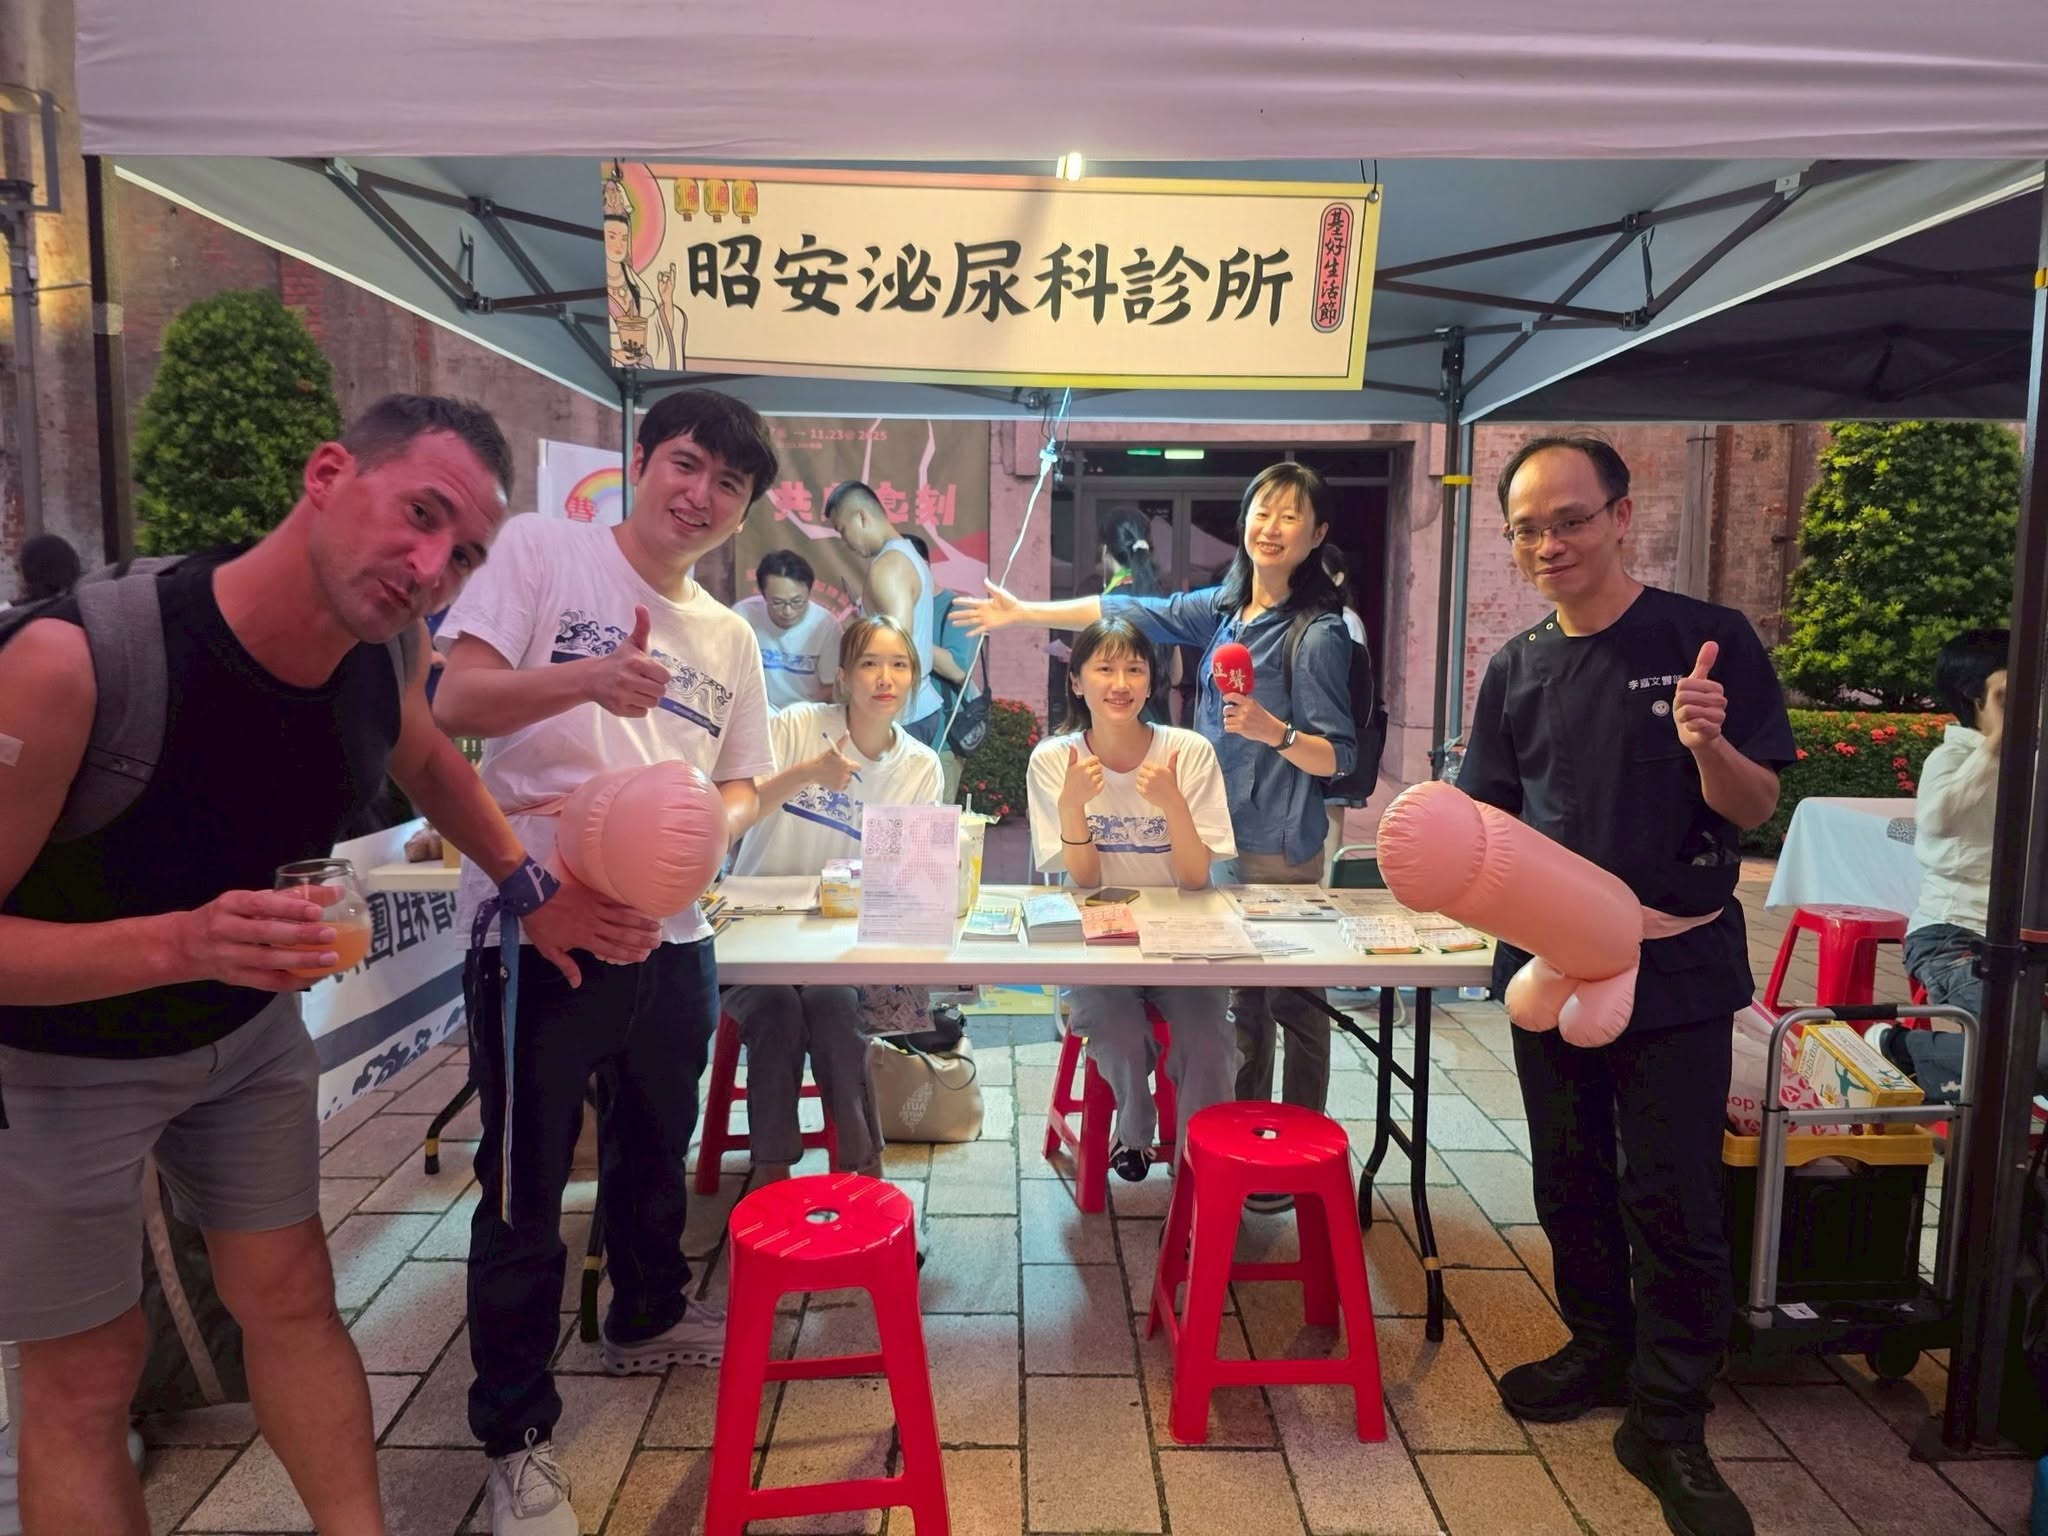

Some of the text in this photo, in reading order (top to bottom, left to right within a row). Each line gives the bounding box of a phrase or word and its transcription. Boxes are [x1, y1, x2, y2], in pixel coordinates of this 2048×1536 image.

[687, 234, 1294, 327] 昭安泌尿科診所
[1319, 208, 1345, 325] 基好生活節
[1727, 1096, 1755, 1112] op
